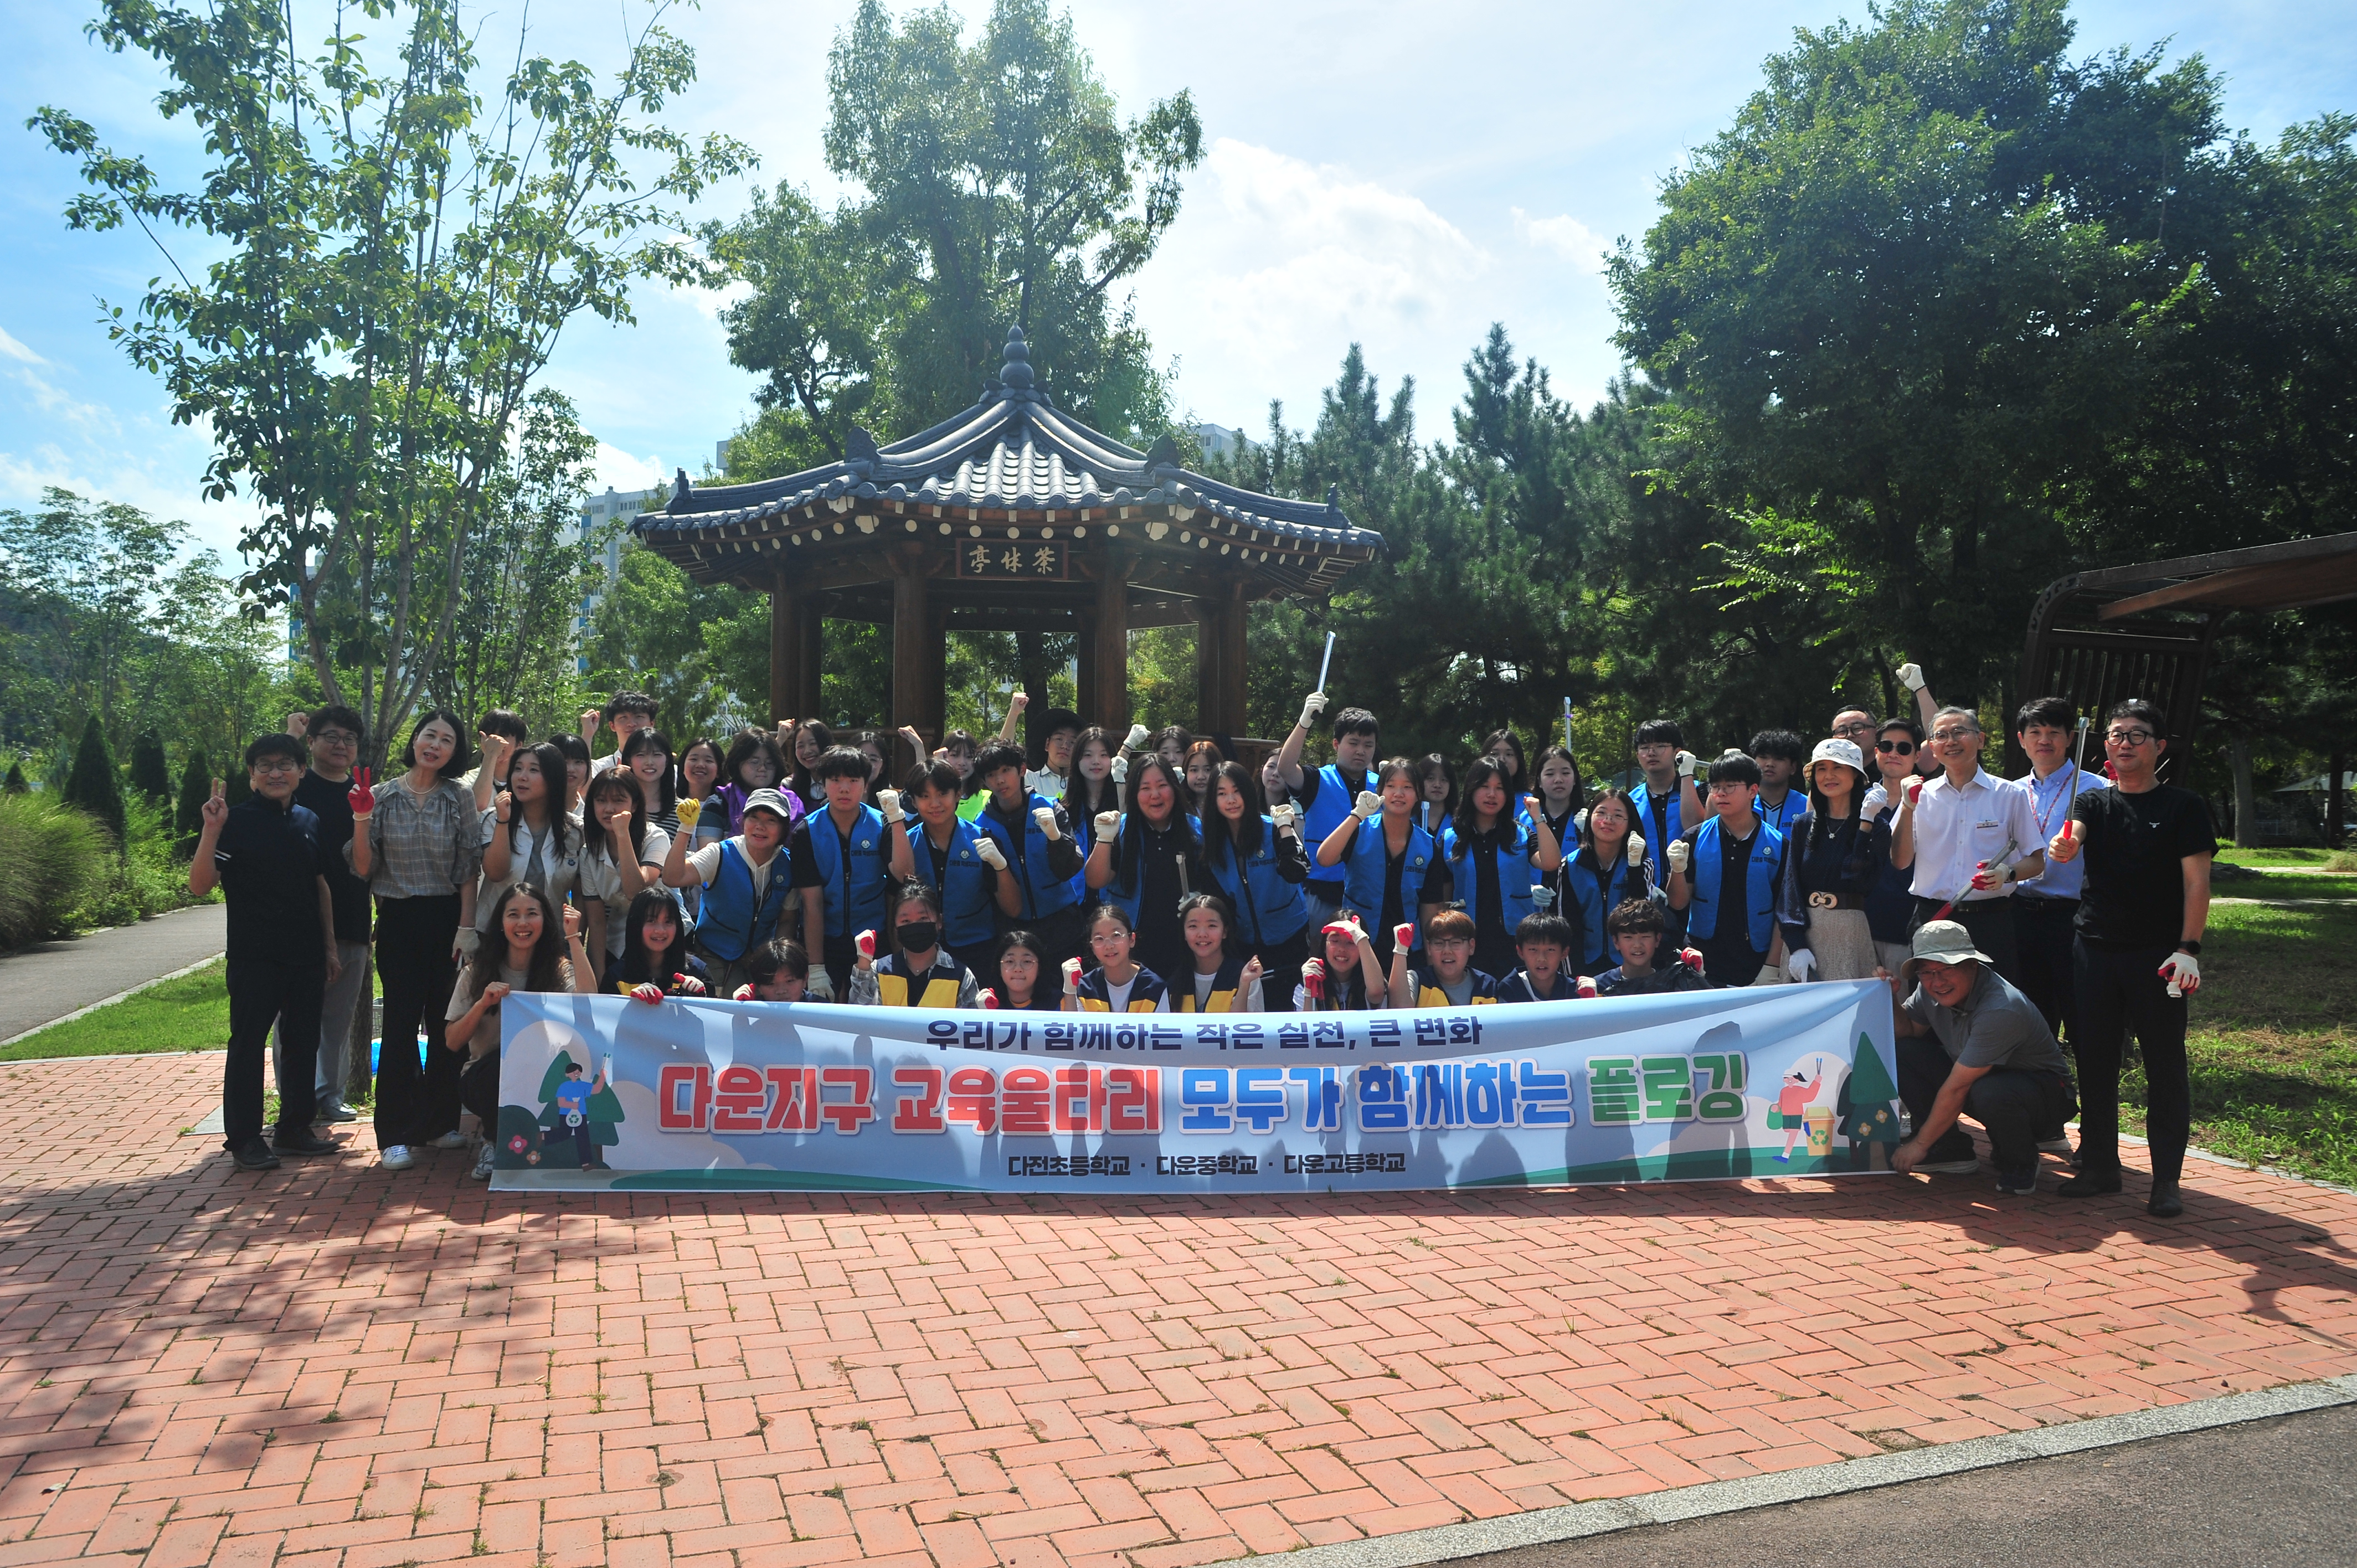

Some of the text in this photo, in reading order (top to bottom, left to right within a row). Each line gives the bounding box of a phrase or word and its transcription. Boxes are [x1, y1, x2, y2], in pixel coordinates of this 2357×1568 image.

[927, 1015, 1483, 1051] 우리가 함께하는 작은 실천, 큰 변화
[659, 1053, 1747, 1134] 다운지구 교육울타리 모두가 함께하는 플로깅
[1008, 1155, 1131, 1176] 다전초등학교
[1156, 1155, 1258, 1175] 다운중학교
[1284, 1153, 1406, 1174] 다운고등학교
